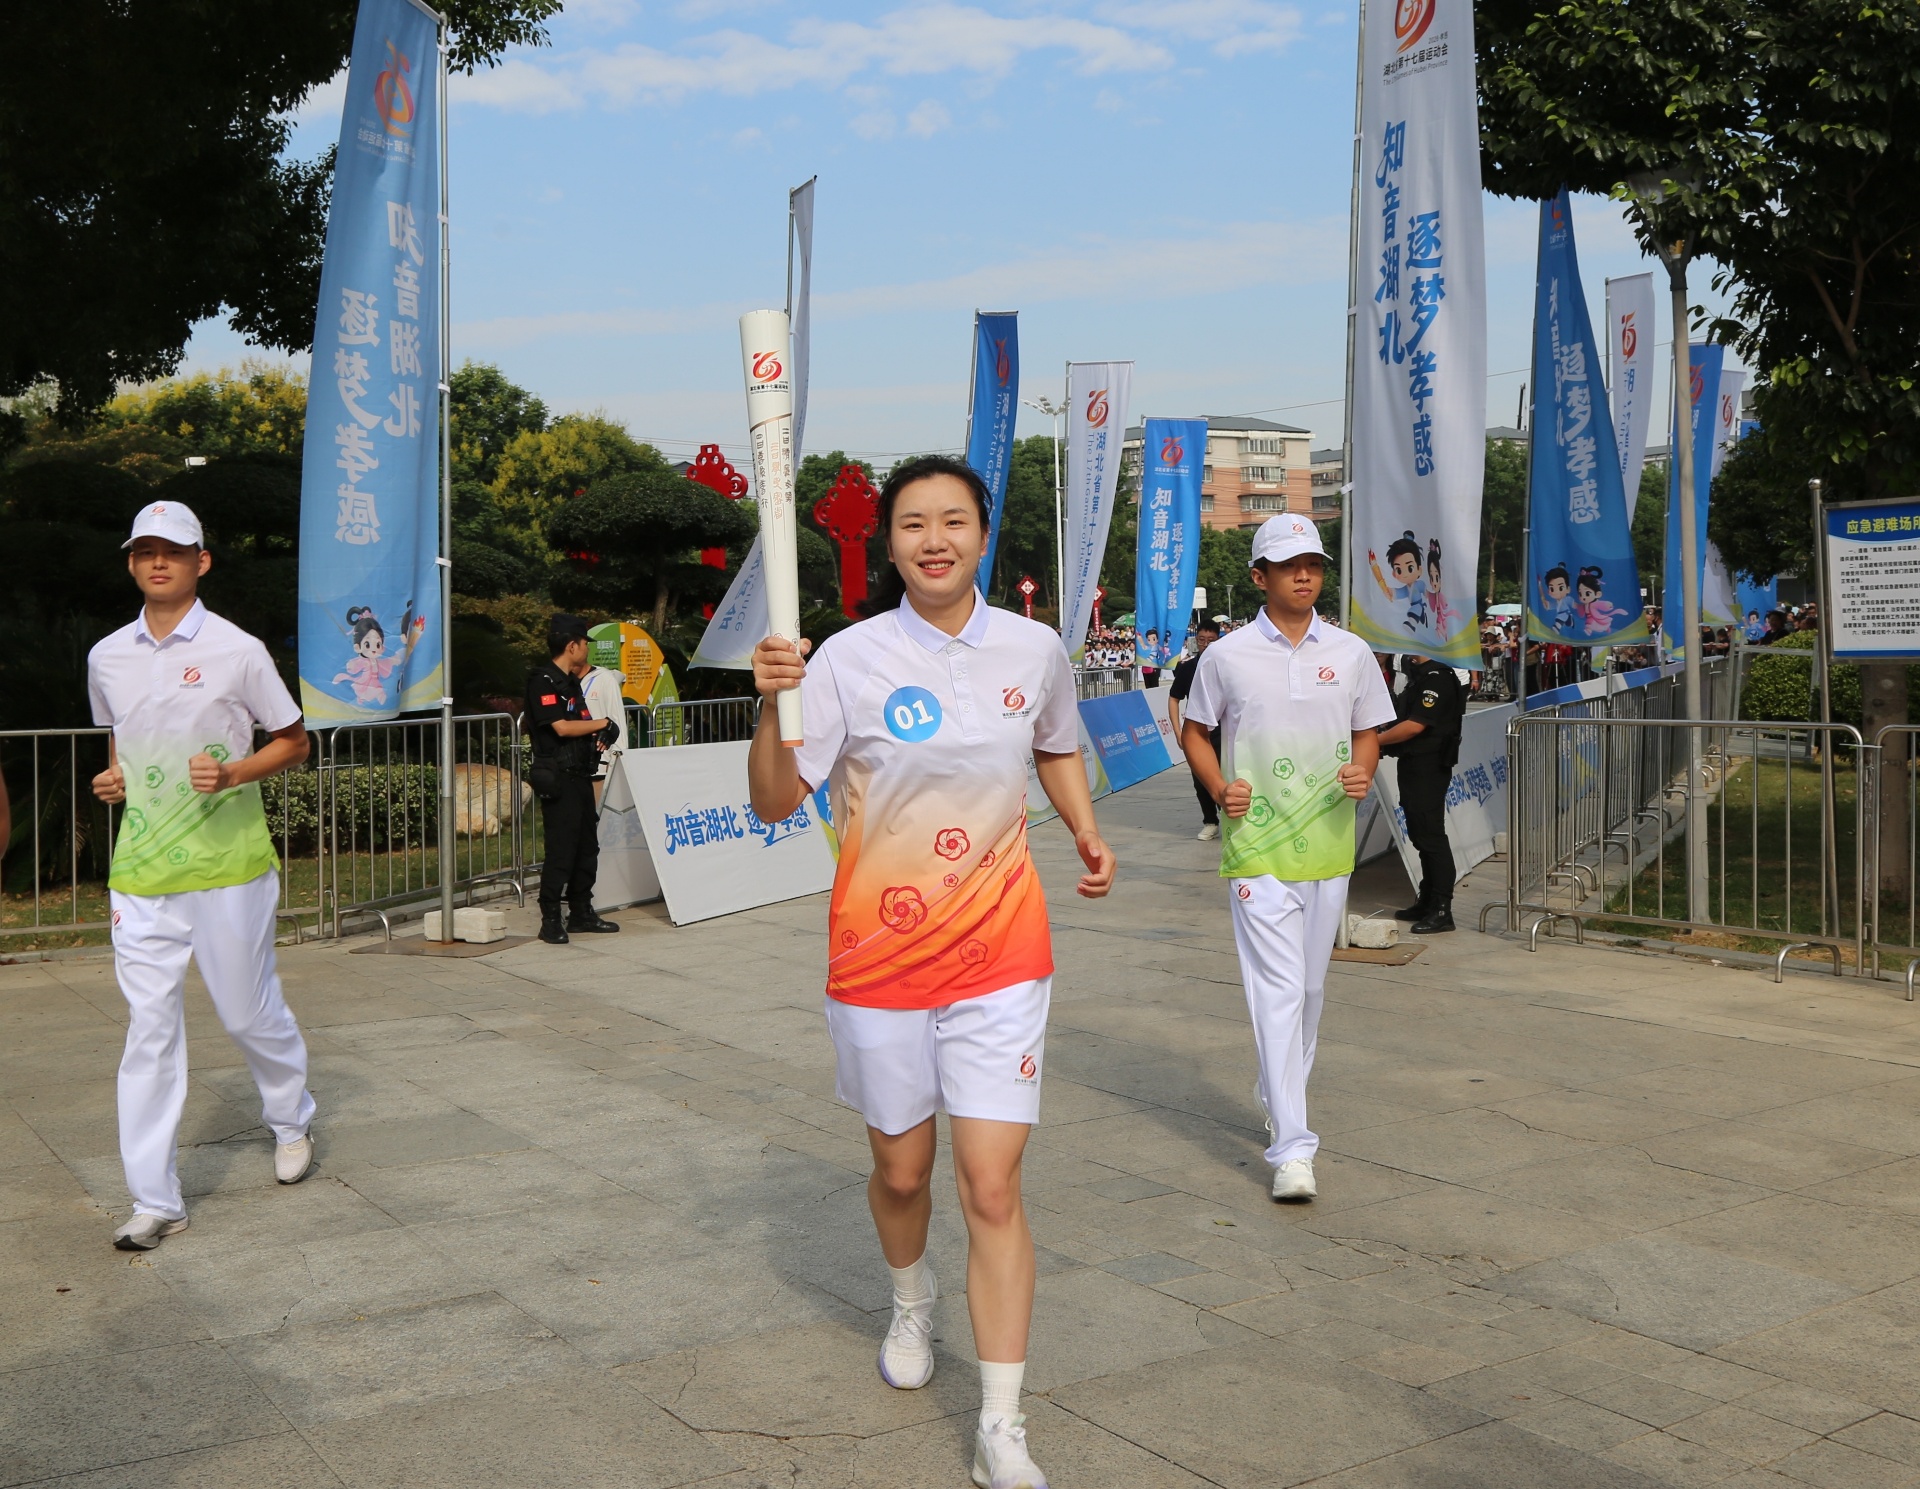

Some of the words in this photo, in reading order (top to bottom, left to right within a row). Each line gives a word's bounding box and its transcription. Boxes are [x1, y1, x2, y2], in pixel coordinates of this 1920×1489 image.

[1375, 120, 1406, 365] 知音湖北
[1405, 210, 1445, 477] 逐梦孝感
[1087, 433, 1095, 455] The
[1560, 342, 1601, 525] 逐梦孝感
[1085, 459, 1093, 485] 17th
[1082, 488, 1091, 530] Games
[1150, 487, 1172, 571] 知音湖北
[1168, 522, 1184, 610] 逐梦孝感
[894, 699, 934, 730] 01
[664, 803, 744, 855] 知音湖北
